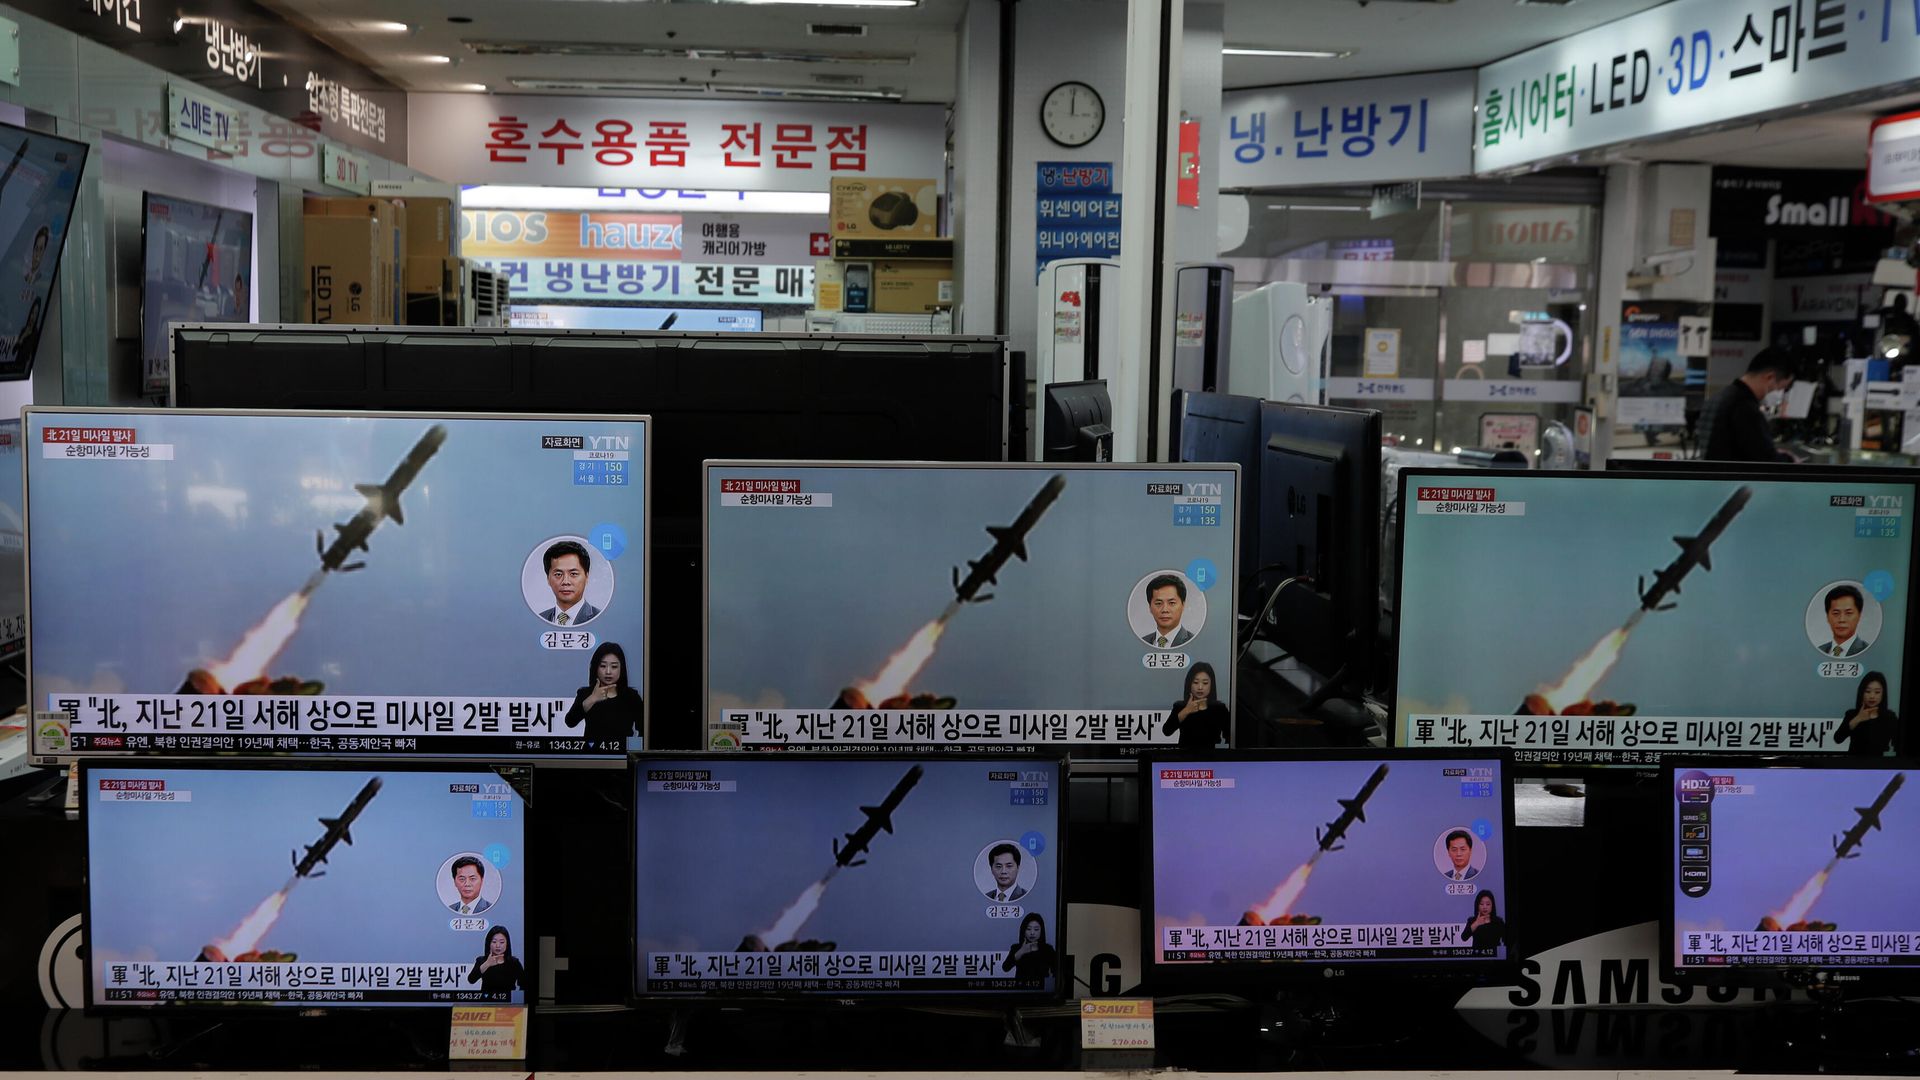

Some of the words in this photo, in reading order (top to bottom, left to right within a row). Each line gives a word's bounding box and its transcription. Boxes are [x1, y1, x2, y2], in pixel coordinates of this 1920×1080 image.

[205, 18, 262, 89] 냉난방기
[309, 71, 339, 123] 업소형
[341, 86, 386, 143] 특판전문점
[181, 98, 212, 136] 스마트
[216, 112, 230, 142] TV
[485, 116, 691, 168] 혼수용품
[719, 122, 869, 172] 전문점
[336, 156, 346, 181] 3D
[348, 158, 359, 184] TV
[1040, 200, 1120, 218] 휘센에어컨
[702, 223, 740, 238] 여행용
[1039, 231, 1120, 249] 위니아에어컨
[317, 266, 332, 300] LED
[545, 261, 680, 295] 냉난방기
[695, 265, 760, 297] 전문
[775, 267, 815, 298] 매
[351, 298, 360, 312] LG
[59, 429, 81, 442] 21일
[82, 429, 111, 442] 미사일
[112, 429, 131, 442] 발사
[544, 437, 581, 448] 자료화면
[589, 436, 629, 449] YTN
[65, 445, 117, 458] 순항미사일
[119, 445, 150, 458] 가능성
[604, 463, 622, 471] 150
[604, 474, 622, 484] 135
[735, 481, 753, 491] 21일
[755, 481, 779, 491] 미사일
[780, 481, 796, 491] 발사
[1149, 484, 1181, 494] 자료화면
[1187, 483, 1222, 495] YTN
[740, 494, 784, 505] 순항미사일
[786, 494, 812, 505] 가능성
[1869, 495, 1903, 507] YTN
[1200, 506, 1216, 514] 150
[1435, 502, 1478, 513] 순항미사일
[1480, 503, 1506, 513] 가능성
[1200, 516, 1216, 525] 135
[136, 698, 183, 730] 지난
[191, 699, 244, 731] 21일
[253, 699, 299, 731] 서해
[307, 700, 378, 731] 상으로
[386, 700, 454, 732] 미사일
[463, 702, 502, 732] 2발
[796, 713, 836, 740] 지난
[843, 713, 888, 740] 21일
[895, 713, 935, 740] 서해
[941, 713, 1002, 741] 상으로
[1009, 713, 1068, 741] 미사일
[1075, 714, 1108, 741] 2발
[1415, 719, 1435, 744] 軍
[1479, 719, 1519, 745] 지난
[1525, 719, 1570, 746] 21일
[1576, 719, 1615, 747] 서해
[1620, 720, 1679, 748] 상으로
[1686, 720, 1743, 748] 미사일
[1749, 722, 1781, 749] 2발
[93, 737, 122, 747] 주요뉴스
[126, 736, 151, 749] 유엔,
[154, 737, 177, 749] 북한
[179, 736, 234, 750] 인권결의안
[238, 737, 274, 750] 19년째
[337, 738, 392, 751] 공동제안국
[394, 738, 417, 751] 빠져
[549, 740, 585, 751] 1343.27
[599, 740, 620, 751] 4.12
[1514, 751, 1561, 762] 인권결의안
[1563, 751, 1593, 762] 19년째
[1169, 930, 1183, 948] 軍
[1214, 929, 1241, 947] 지난
[1245, 929, 1276, 947] 21일
[1281, 928, 1308, 947] 서해
[1311, 928, 1353, 947] 상으로
[1358, 926, 1397, 946] 미사일
[1402, 926, 1424, 945] 2발
[1688, 934, 1702, 951] 軍
[1732, 935, 1758, 952] 지난
[1763, 935, 1792, 952] 21일
[1796, 935, 1823, 952] 서해
[1827, 935, 1866, 953] 상으로
[1872, 935, 1910, 953] 미사일
[654, 956, 670, 976] 軍
[707, 955, 740, 977] 지난
[744, 956, 782, 976] 21일
[787, 955, 820, 977] 서해
[824, 955, 874, 977] 상으로
[879, 954, 926, 976] 미사일
[932, 955, 958, 976] 2발
[112, 965, 128, 986] 軍
[166, 966, 199, 986] 지난
[205, 966, 242, 987] 21일
[248, 966, 281, 987] 서해
[286, 966, 336, 987] 상으로
[341, 966, 389, 987] 미사일
[396, 967, 423, 987] 2발
[453, 1012, 491, 1021] SAVE!
[1098, 1005, 1136, 1014] SAVE!
